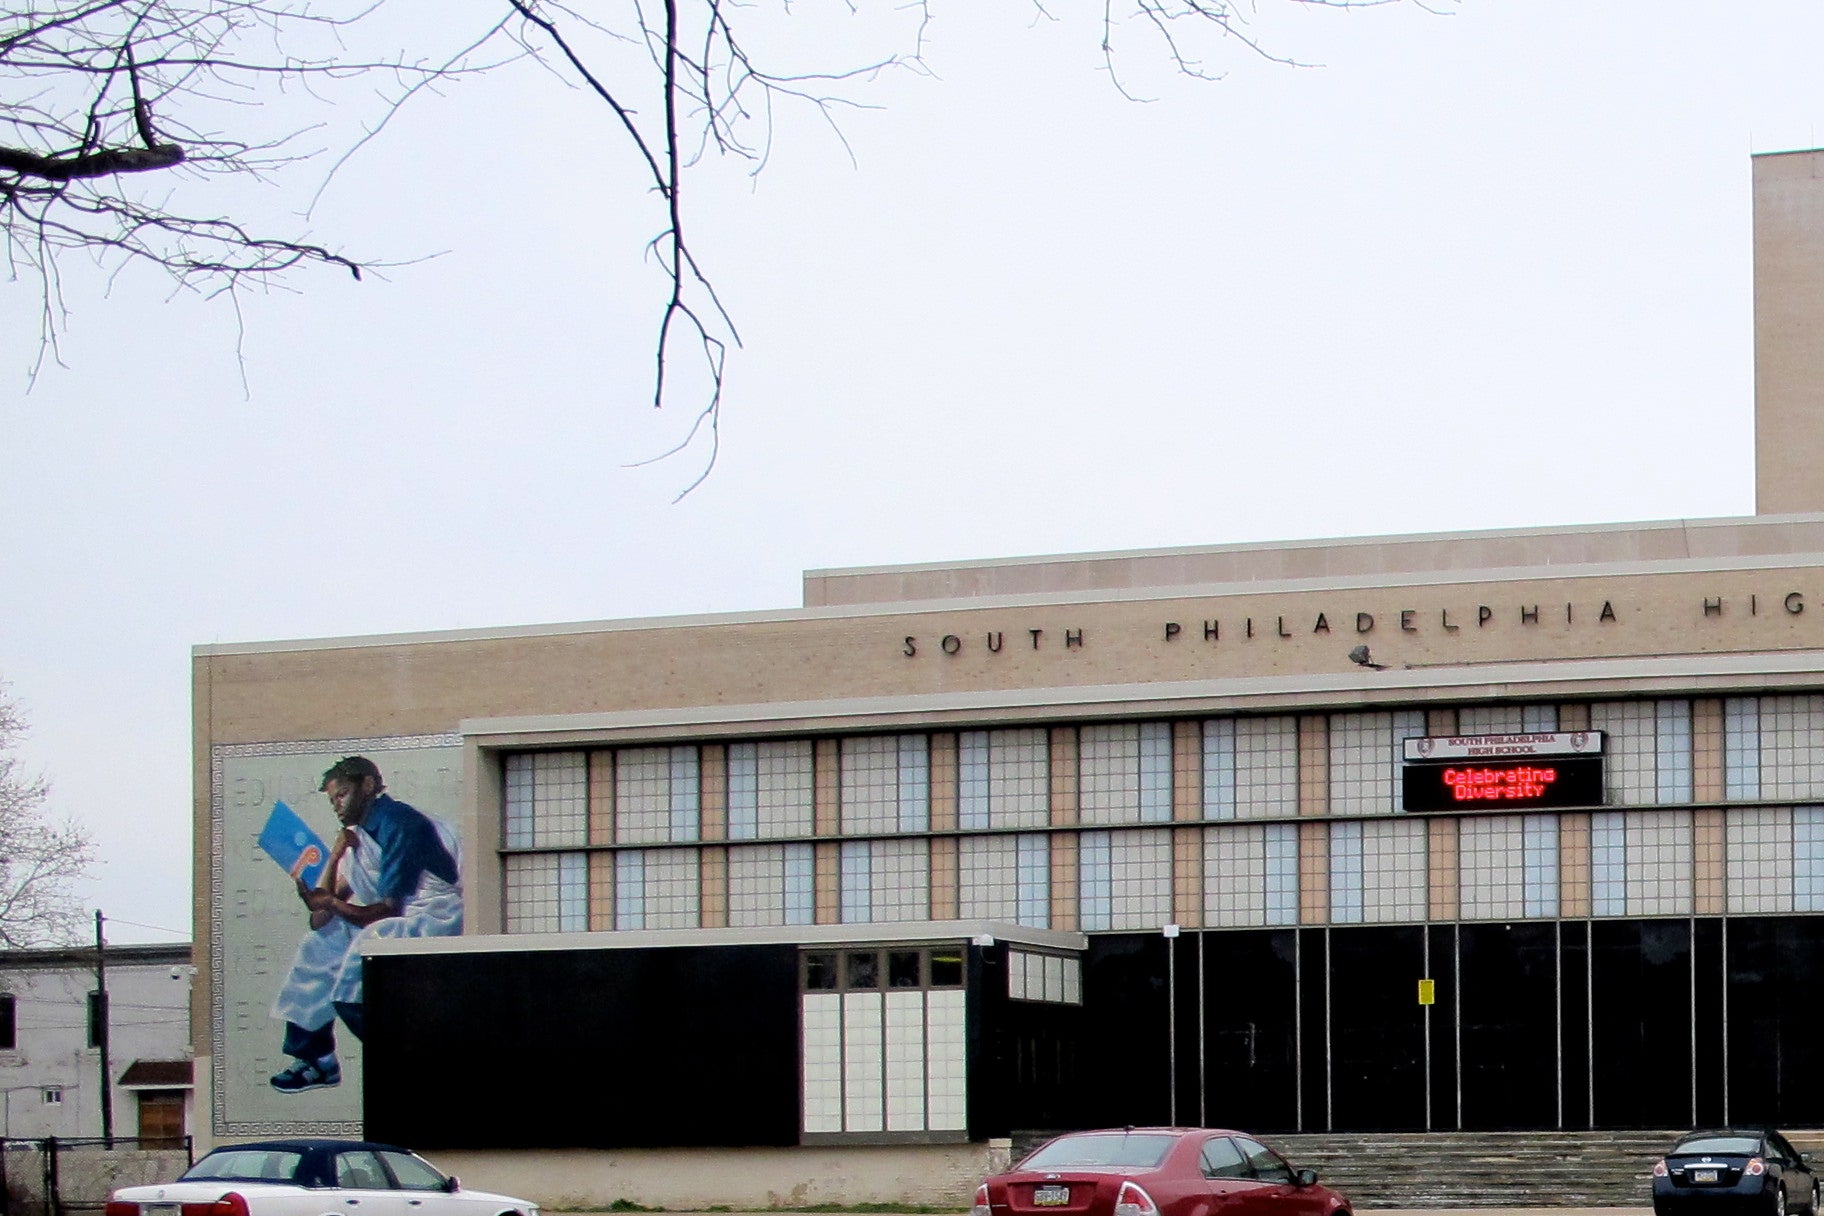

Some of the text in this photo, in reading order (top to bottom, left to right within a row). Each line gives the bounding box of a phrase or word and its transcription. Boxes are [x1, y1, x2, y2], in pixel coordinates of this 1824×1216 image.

[902, 628, 1084, 658] SOUTH
[1163, 600, 1618, 643] PHILADELPHIA
[1447, 733, 1557, 747] SOUTH PHILADELPHIA
[1467, 745, 1537, 756] HIGH SCHOOL
[1444, 766, 1555, 785] Celebrating
[1455, 782, 1545, 800] Diversity
